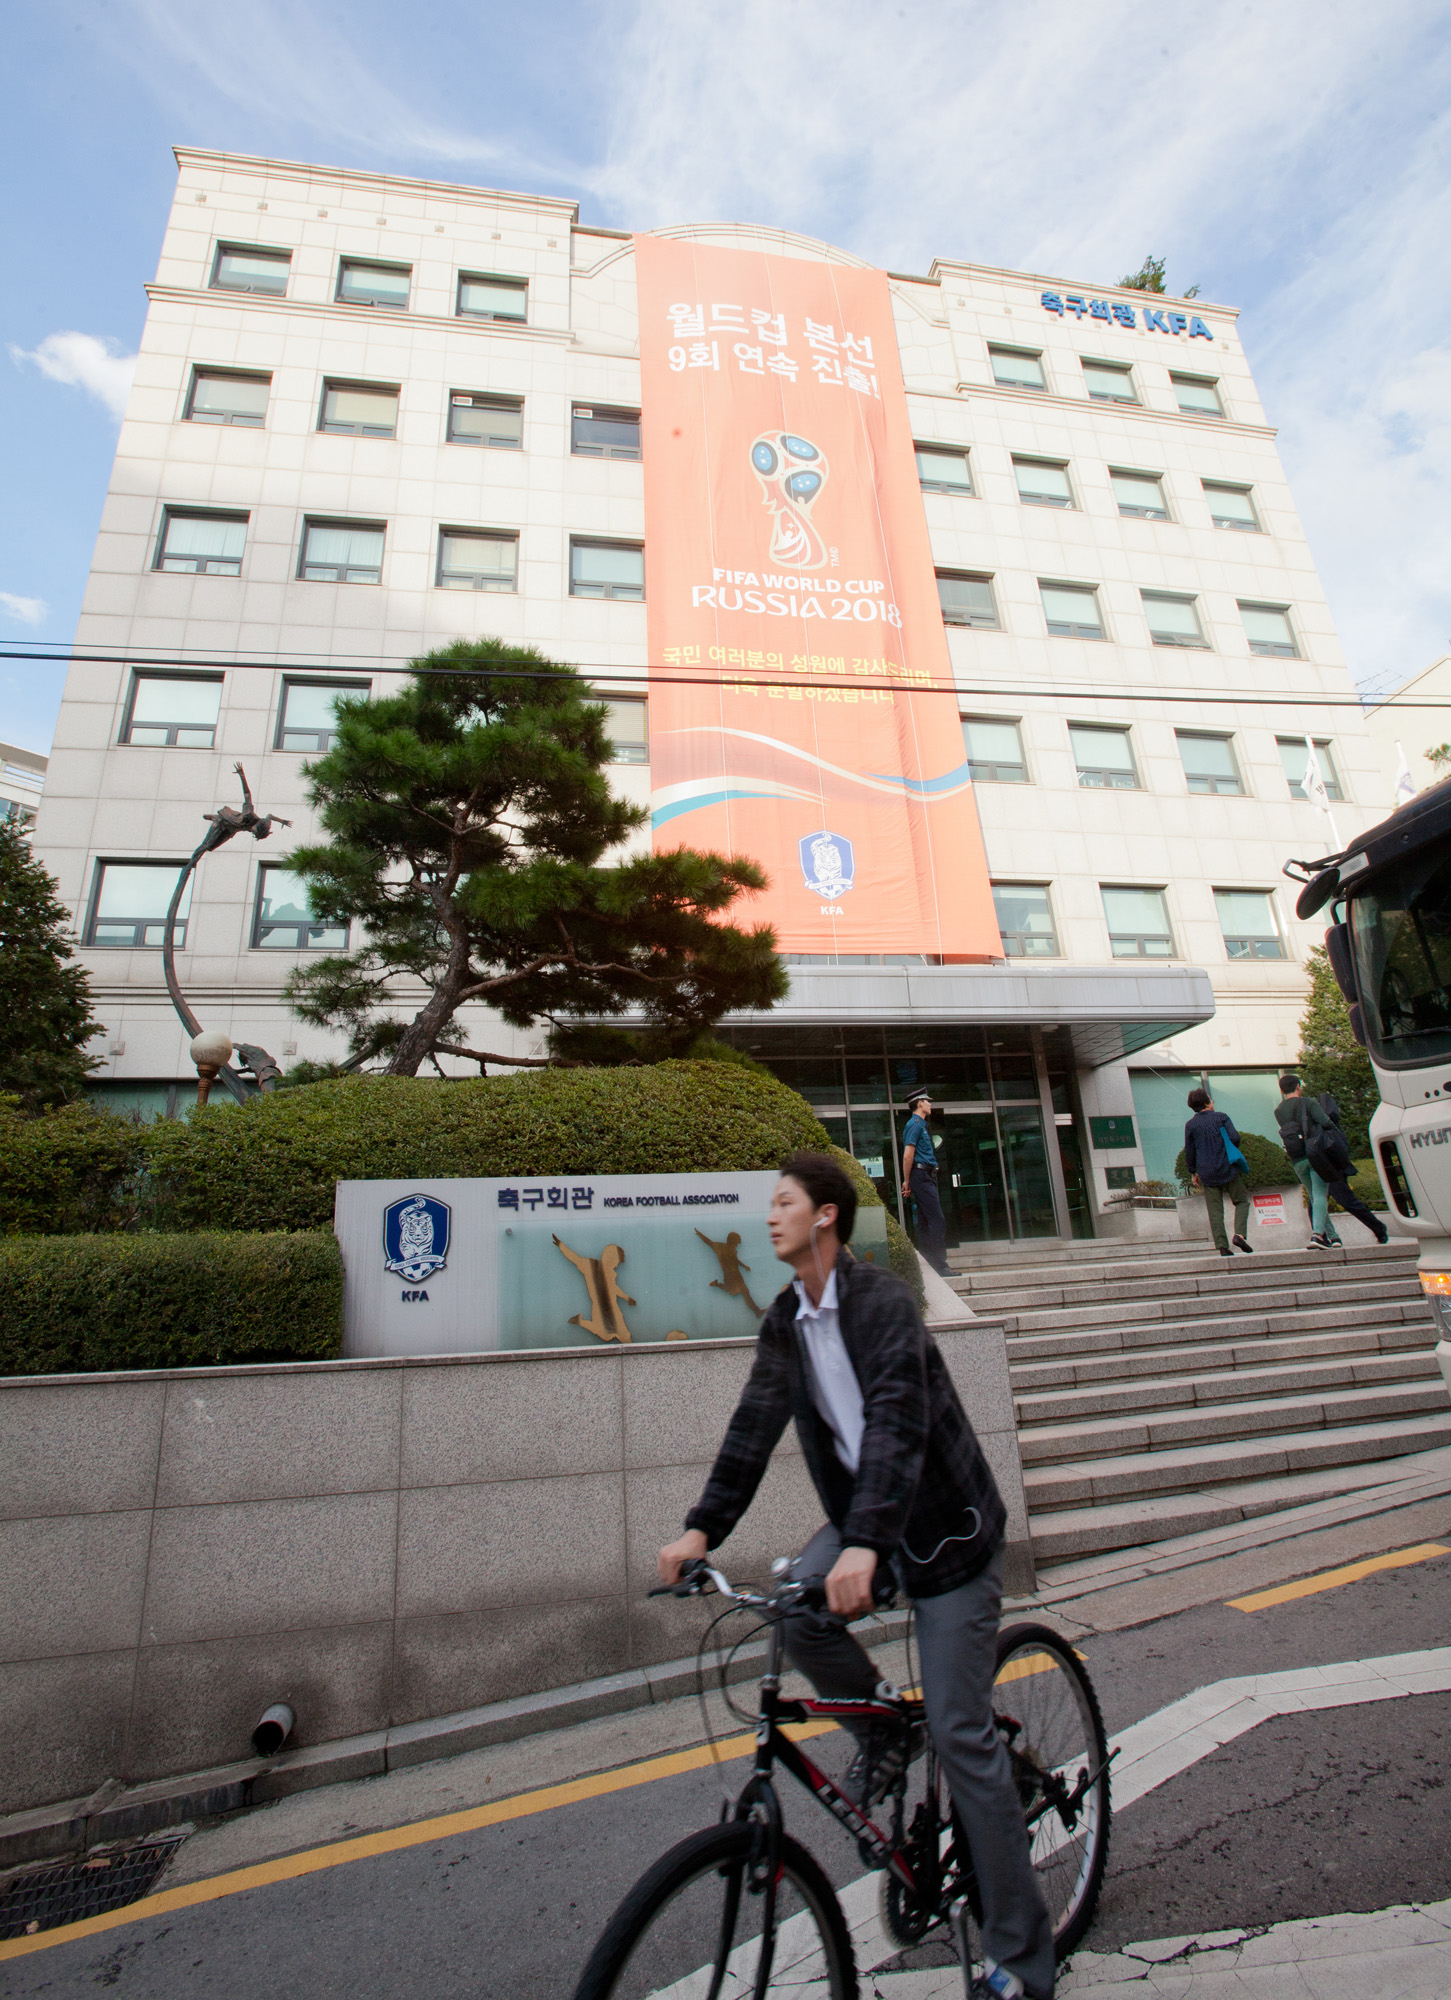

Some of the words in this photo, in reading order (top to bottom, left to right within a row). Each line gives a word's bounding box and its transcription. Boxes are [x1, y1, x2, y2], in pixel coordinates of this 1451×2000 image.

[666, 303, 788, 346] 월드컵
[803, 317, 876, 369] 본선
[1041, 291, 1137, 329] 축구회관
[1143, 308, 1214, 341] KFA
[668, 340, 720, 372] 9회
[733, 342, 799, 383] 연속
[811, 354, 881, 400] 진출!
[713, 567, 760, 587] FIFA
[762, 573, 842, 593] WORLD
[845, 580, 885, 594] CUP
[691, 585, 827, 619] RUSSIA
[831, 598, 903, 628] 2018
[662, 645, 701, 666] 국민
[708, 645, 784, 671] 여러분의
[790, 654, 846, 675] 성원에
[851, 657, 939, 689] 감사드리며,
[820, 905, 844, 915] KFA
[497, 1186, 594, 1212] 축구회관
[603, 1197, 635, 1208] KOREA
[636, 1195, 681, 1207] FOOTBALL
[682, 1193, 739, 1205] ASSOCIATION
[401, 1290, 430, 1302] KFA
